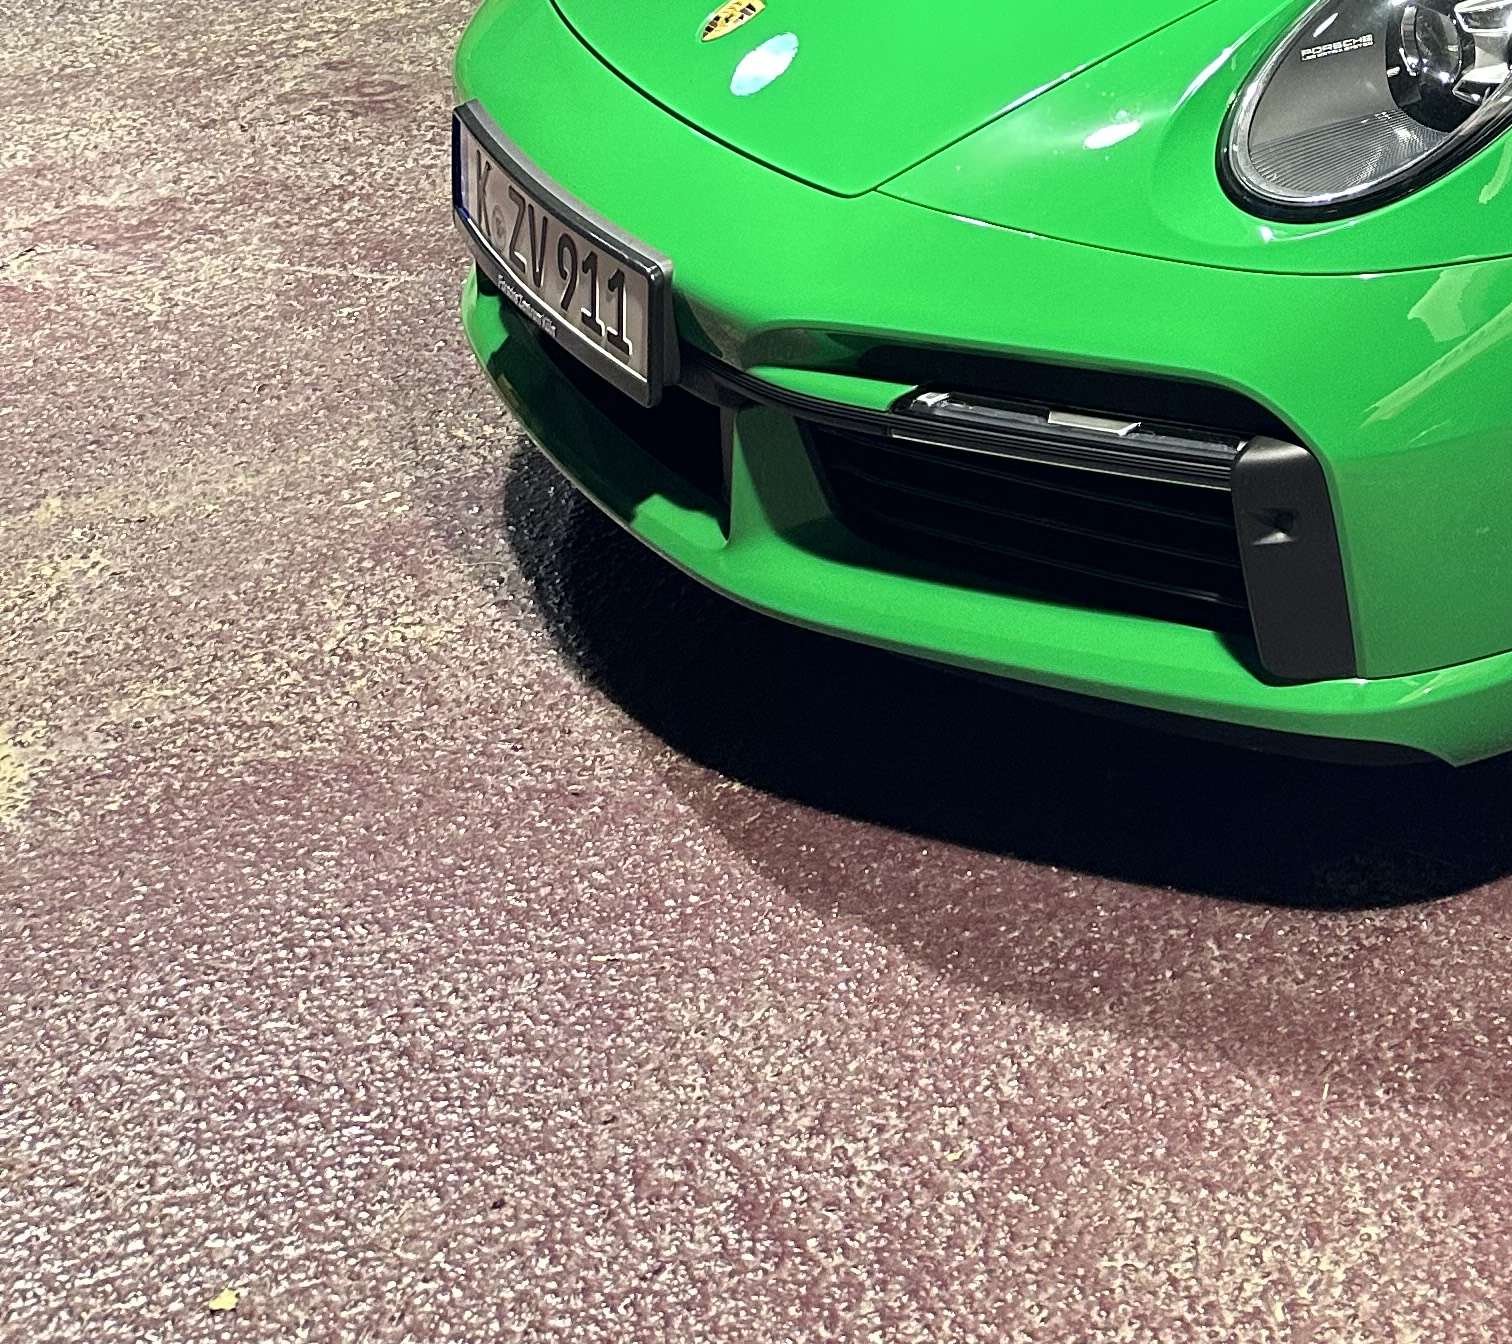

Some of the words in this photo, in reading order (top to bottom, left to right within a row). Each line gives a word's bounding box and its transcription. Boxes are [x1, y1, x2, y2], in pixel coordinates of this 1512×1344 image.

[476, 149, 491, 237] K
[508, 184, 549, 289] ZV
[557, 232, 634, 357] 911
